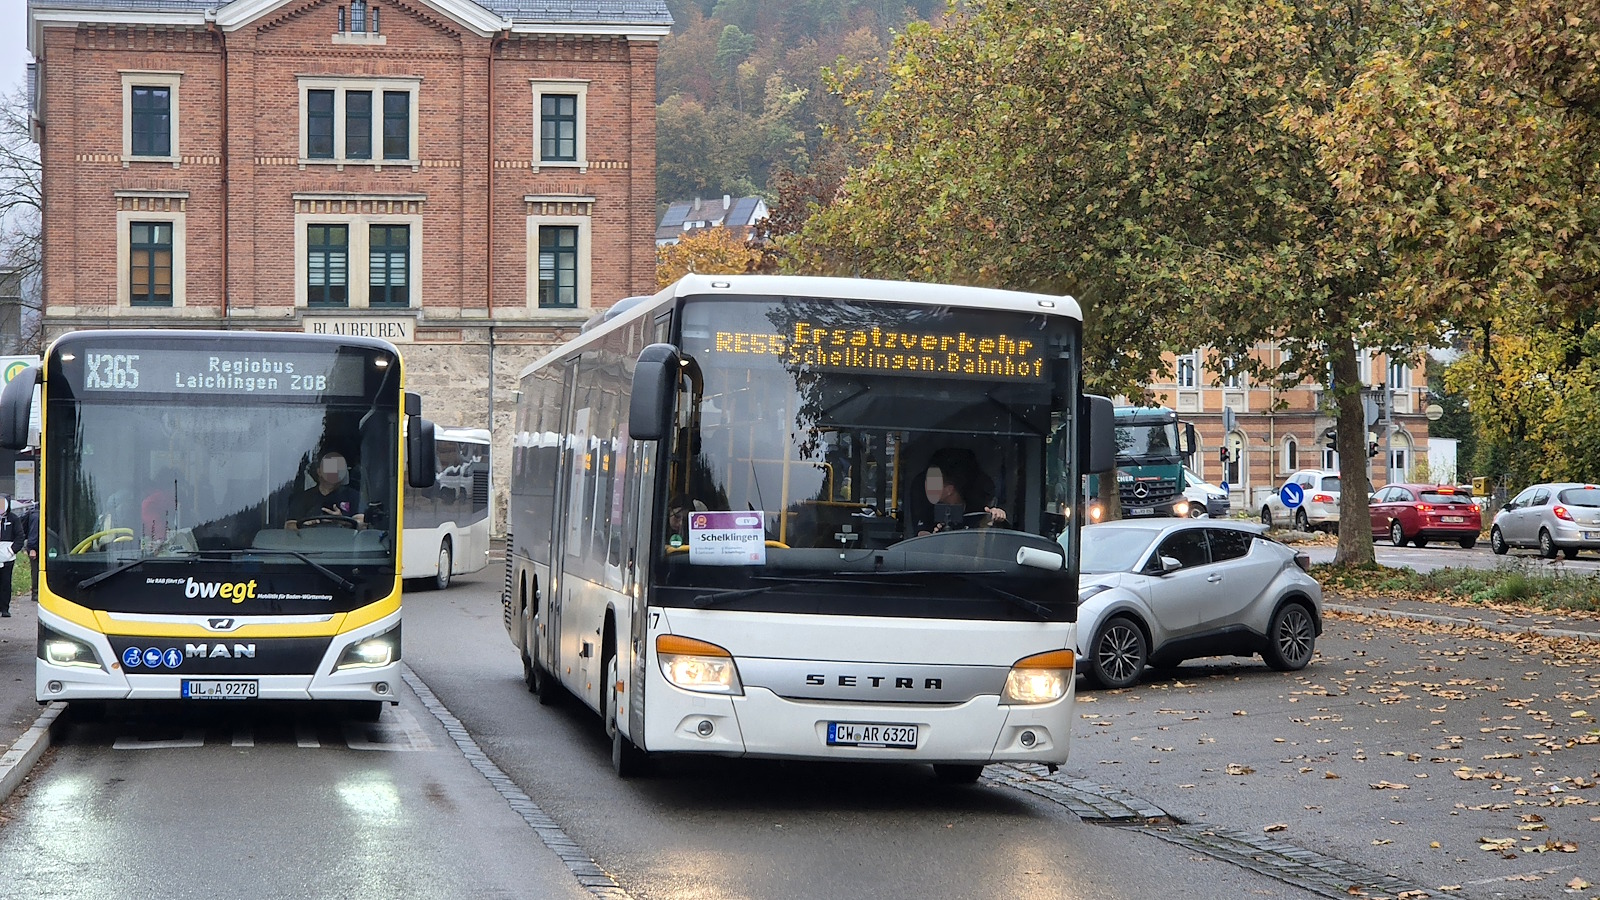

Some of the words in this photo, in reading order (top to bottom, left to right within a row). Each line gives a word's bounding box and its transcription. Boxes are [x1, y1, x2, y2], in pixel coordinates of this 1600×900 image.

[313, 322, 406, 337] BLAUBEUREN
[716, 331, 787, 355] RE55
[795, 322, 1033, 356] Ersatzverkehr
[86, 353, 140, 390] X365
[209, 356, 295, 375] Regiobus
[175, 371, 278, 391] Laichingen
[290, 374, 327, 391] ZOB
[700, 533, 759, 543] Schelklingen
[184, 577, 258, 604] bwegt
[185, 643, 256, 659] MAN
[190, 683, 206, 695] UL
[215, 683, 223, 695] A
[225, 683, 256, 695] 9278
[805, 674, 944, 690] SETRA
[837, 726, 855, 740] CW
[862, 727, 879, 742] AR
[882, 728, 915, 743] 6320
